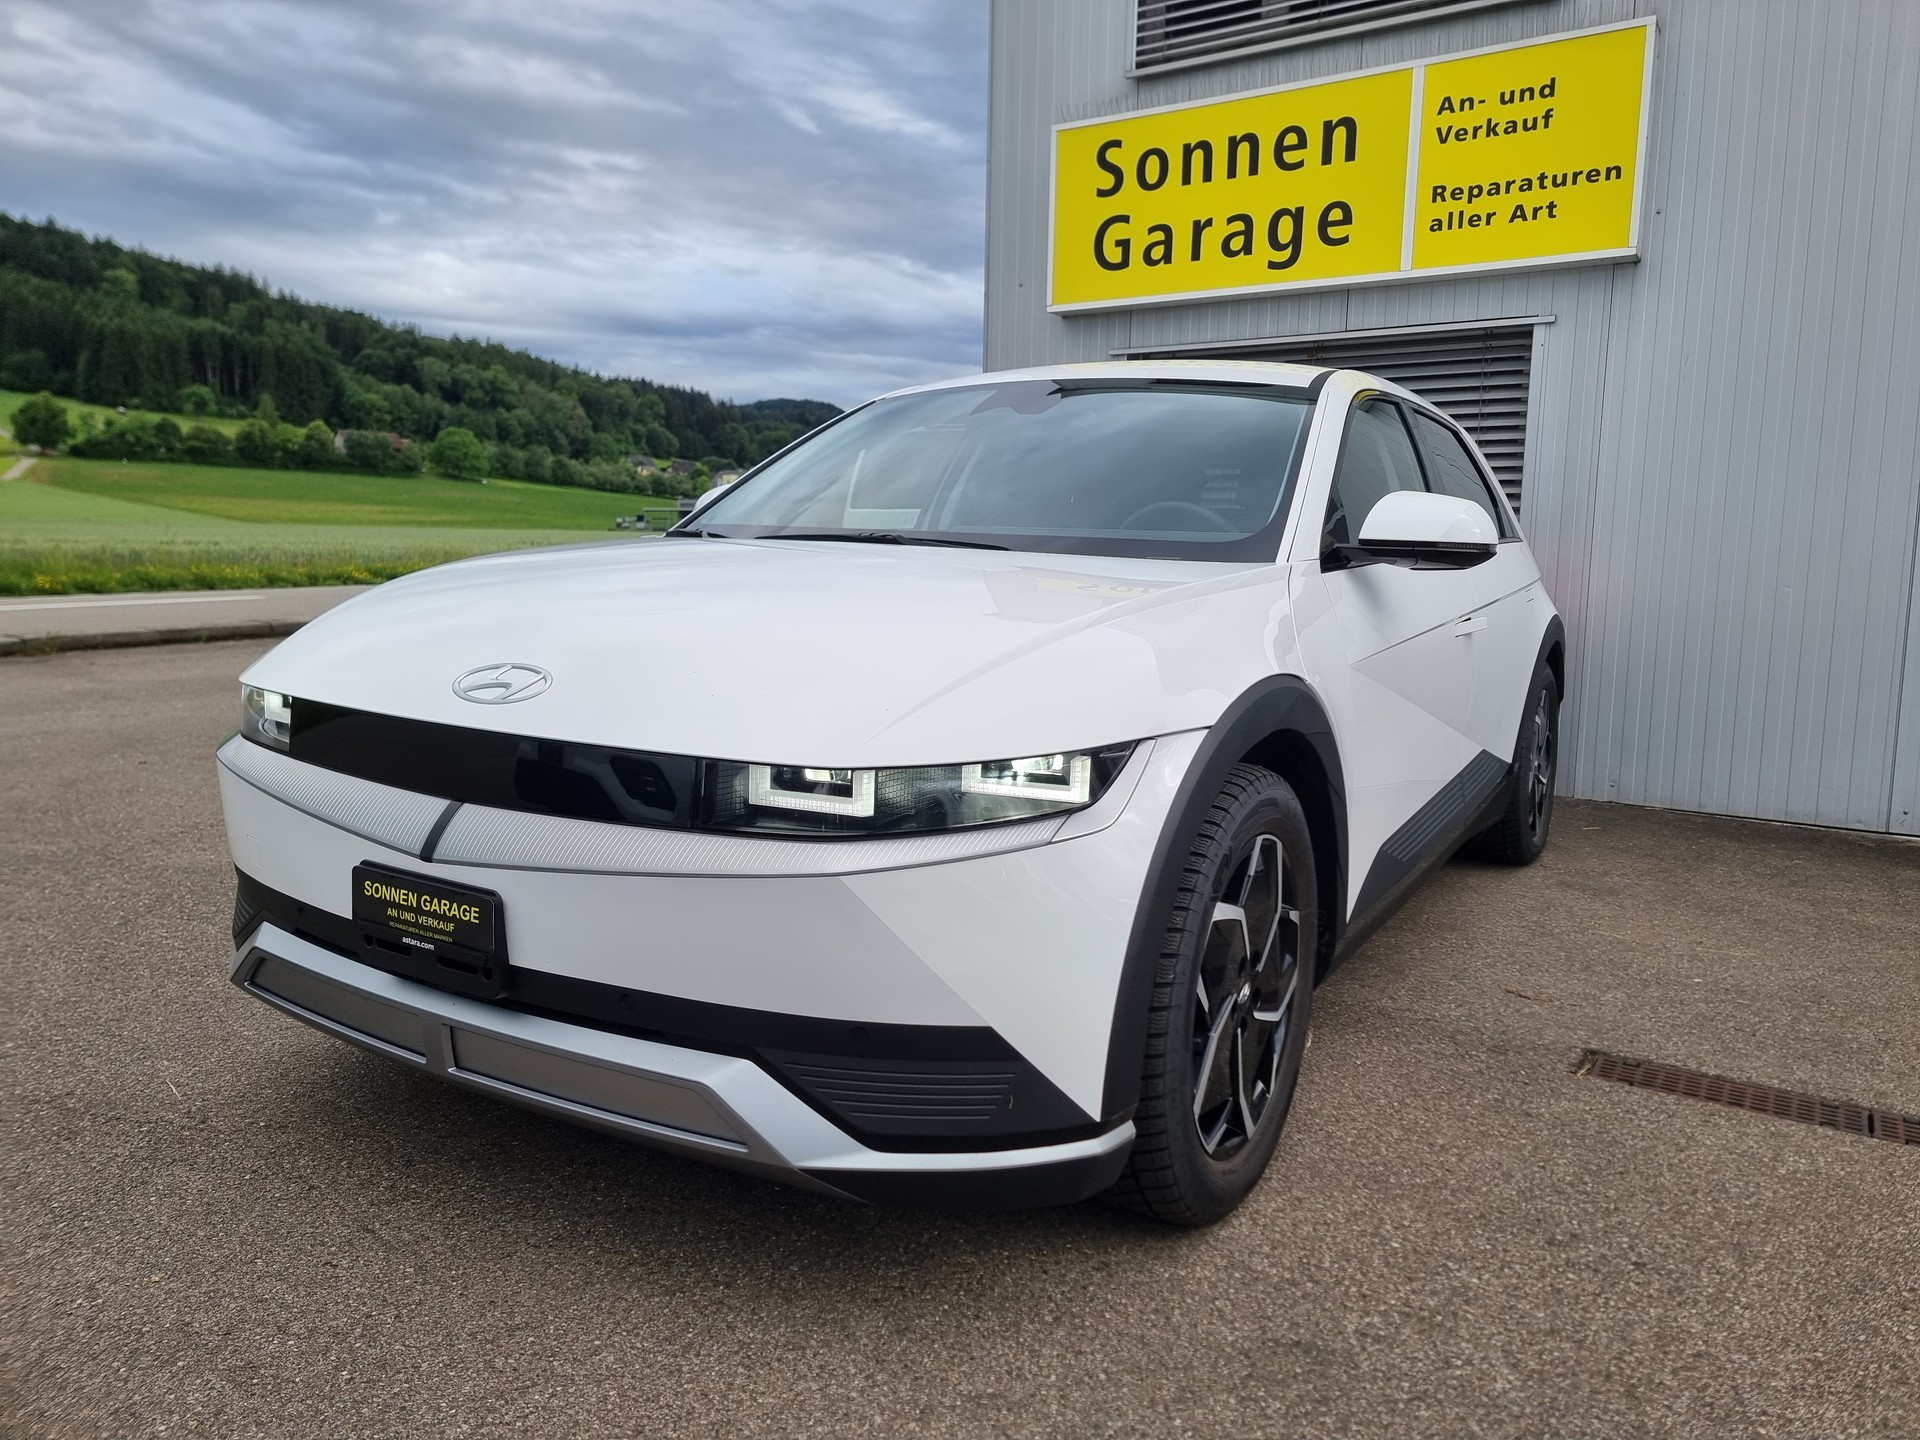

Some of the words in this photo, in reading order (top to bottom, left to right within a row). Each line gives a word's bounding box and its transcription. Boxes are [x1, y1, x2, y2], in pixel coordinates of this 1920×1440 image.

[1436, 96, 1486, 116] An-
[1499, 76, 1556, 106] und
[1435, 107, 1554, 145] Verkauf
[1096, 116, 1358, 198] Sonnen
[1431, 165, 1622, 205] Reparaturen
[1093, 200, 1353, 272] Garage
[1429, 209, 1497, 233] aller
[1508, 200, 1558, 224] Art
[364, 881, 417, 908] SONNEN
[421, 895, 480, 924] GARAGE
[387, 908, 398, 918] AN
[399, 910, 416, 923] UND
[417, 914, 455, 932] VERKAUF
[402, 937, 435, 950] astara.com
